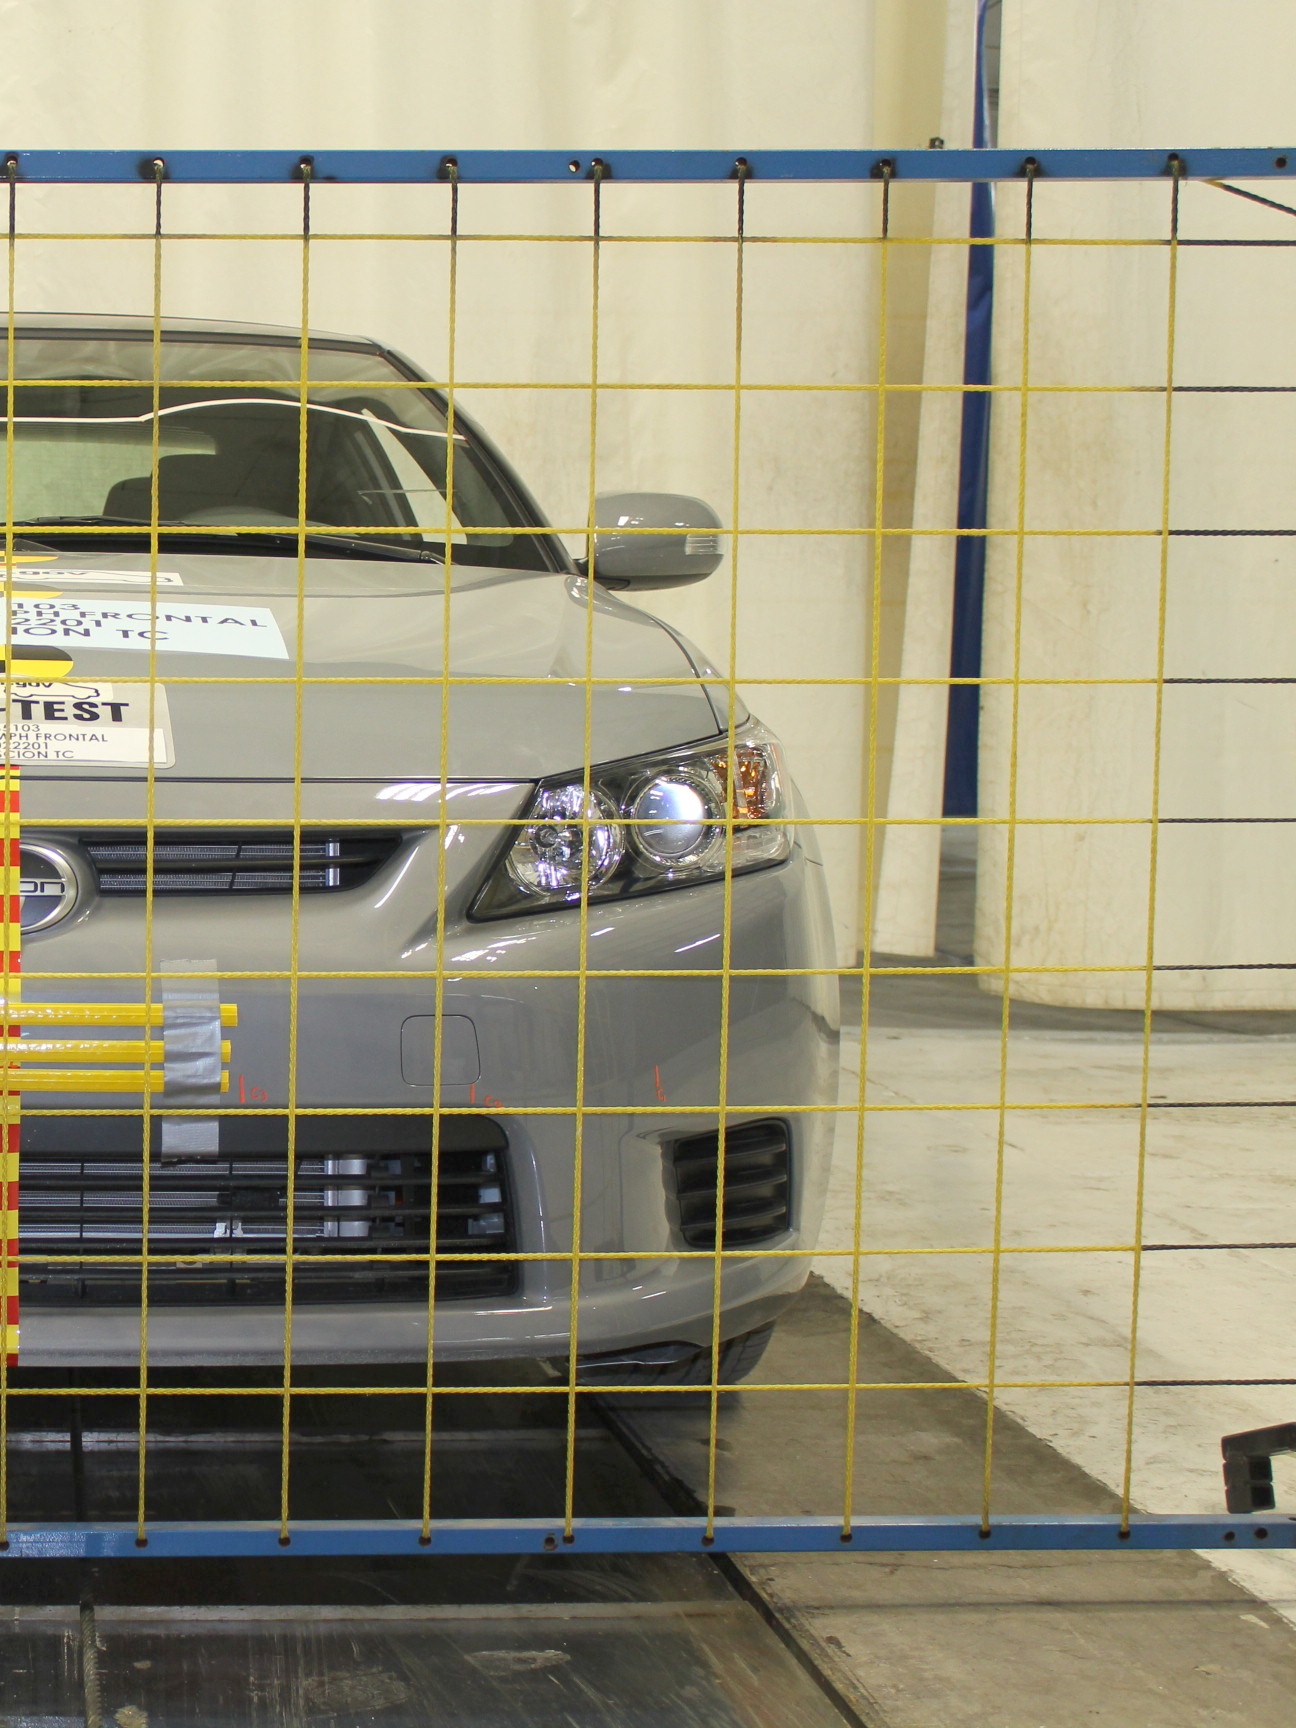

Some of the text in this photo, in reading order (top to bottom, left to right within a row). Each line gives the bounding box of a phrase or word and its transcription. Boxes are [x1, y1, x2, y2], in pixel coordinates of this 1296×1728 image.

[79, 611, 268, 628] FRONTAL
[116, 629, 170, 641] TC
[35, 732, 109, 743] FRONTAL
[54, 749, 75, 760] TC
